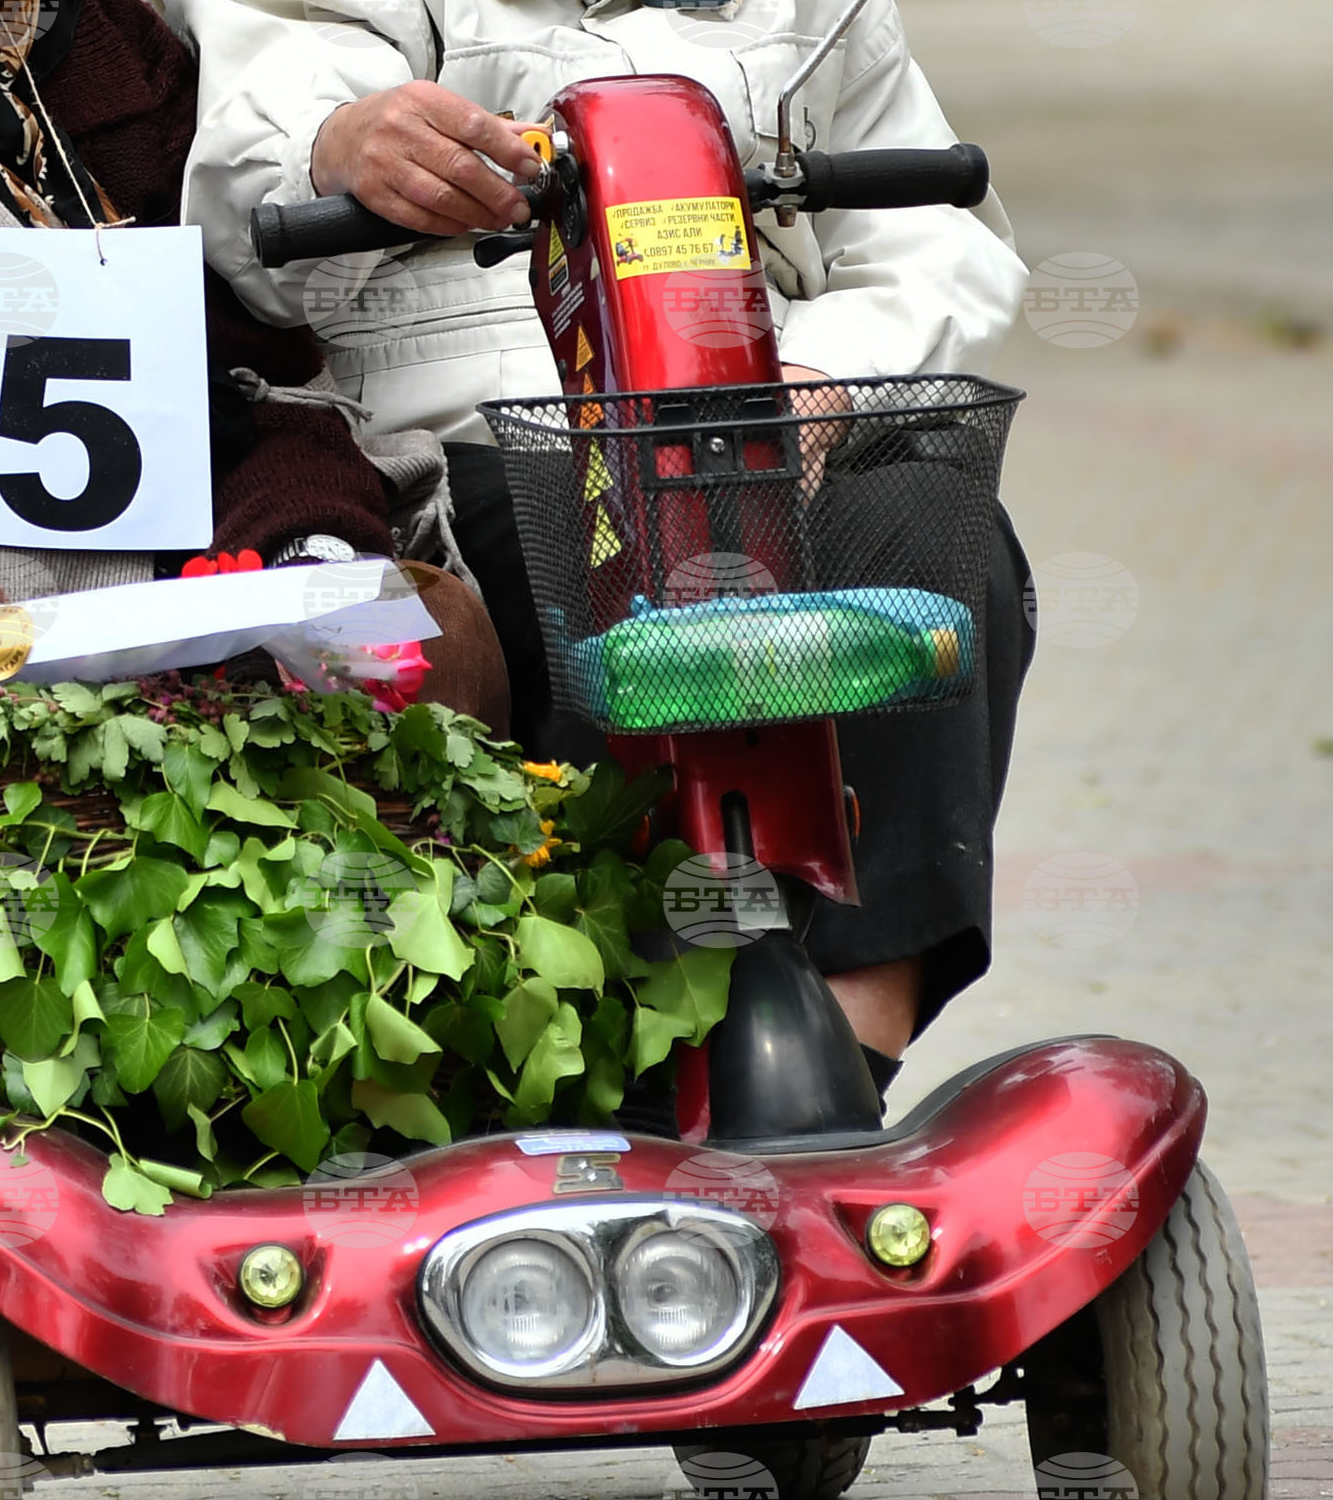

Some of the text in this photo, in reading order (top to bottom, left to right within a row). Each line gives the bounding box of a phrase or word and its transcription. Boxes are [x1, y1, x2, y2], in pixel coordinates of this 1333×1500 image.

[616, 201, 735, 219] ПРОДАЖБА АКУМУЛАТОРИ
[624, 213, 735, 229] СЕРВИЗ РЕЗЕРВНИ ЧАСТИ
[657, 227, 703, 240] АЗИС АЛИ
[649, 246, 672, 257] 0897
[675, 244, 687, 255] 45
[702, 242, 714, 253] 67
